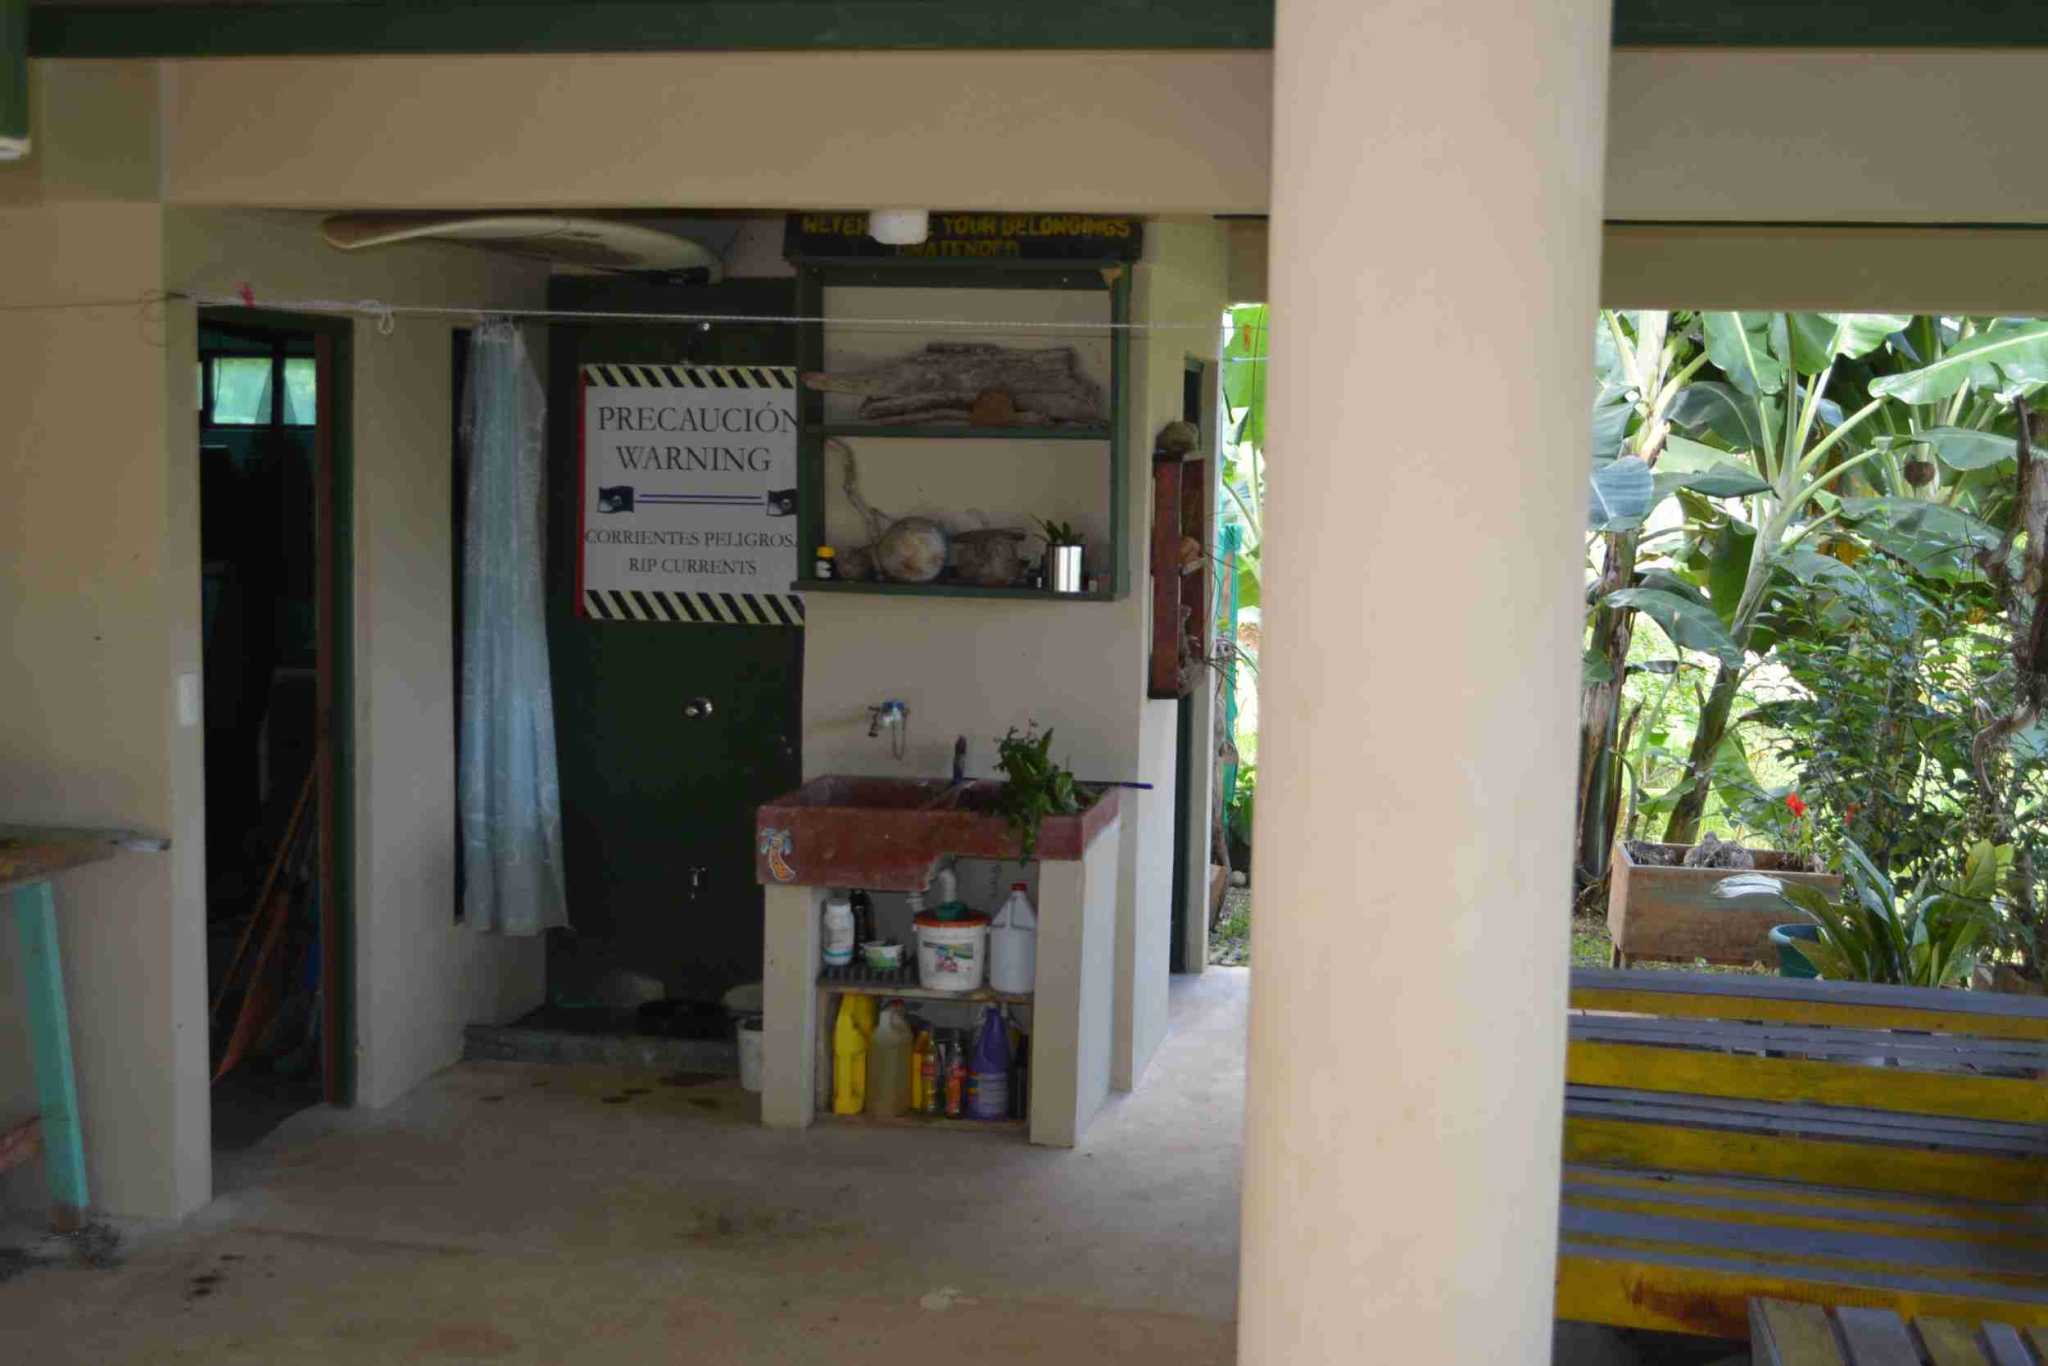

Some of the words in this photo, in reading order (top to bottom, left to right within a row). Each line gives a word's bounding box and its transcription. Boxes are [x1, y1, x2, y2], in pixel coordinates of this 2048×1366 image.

[942, 215, 996, 236] YOUR
[616, 446, 772, 472] WARNING
[584, 528, 699, 546] CORRIENTES
[704, 531, 798, 548] PELIGROS
[629, 557, 657, 573] RIP
[661, 558, 757, 575] CURRENTS
